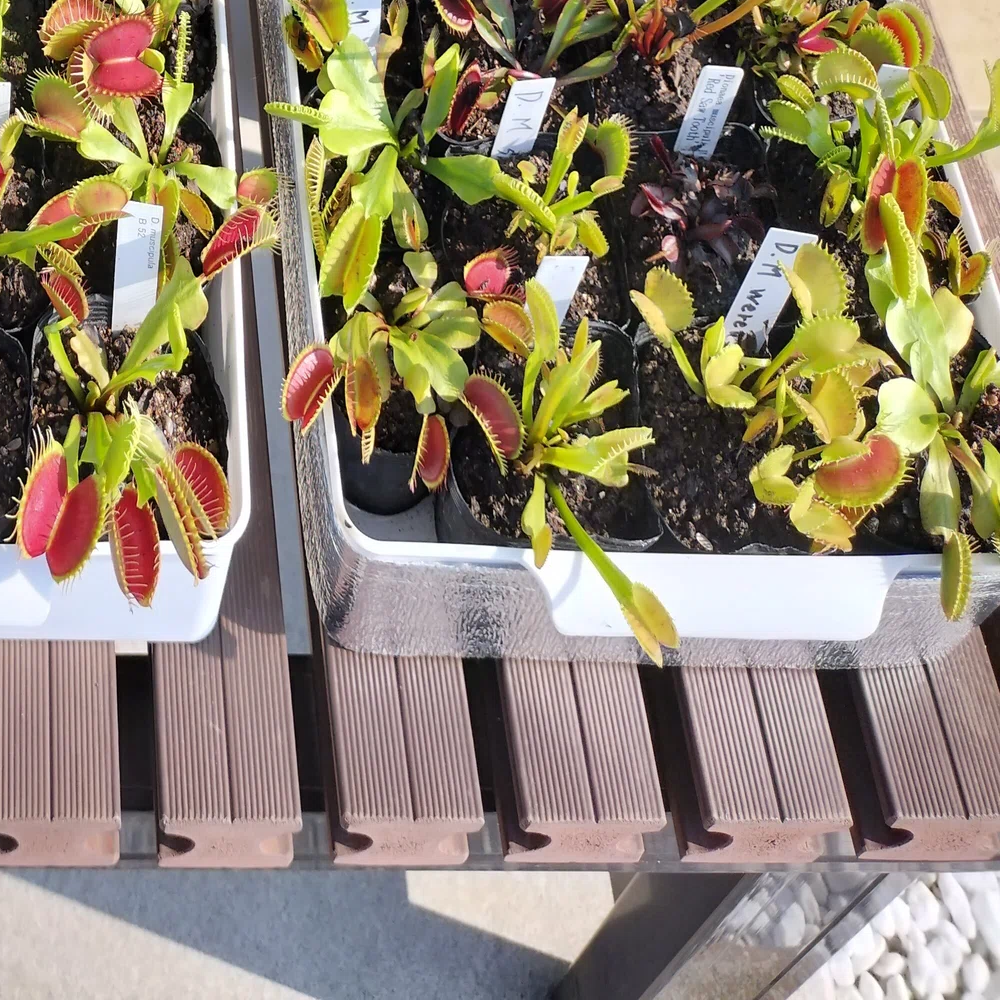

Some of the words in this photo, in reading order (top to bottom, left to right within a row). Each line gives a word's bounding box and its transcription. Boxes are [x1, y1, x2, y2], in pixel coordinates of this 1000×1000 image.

[715, 74, 736, 106] Dionaea
[506, 90, 545, 134] D.M
[147, 228, 157, 269] muscipula
[756, 242, 800, 278] D.M
